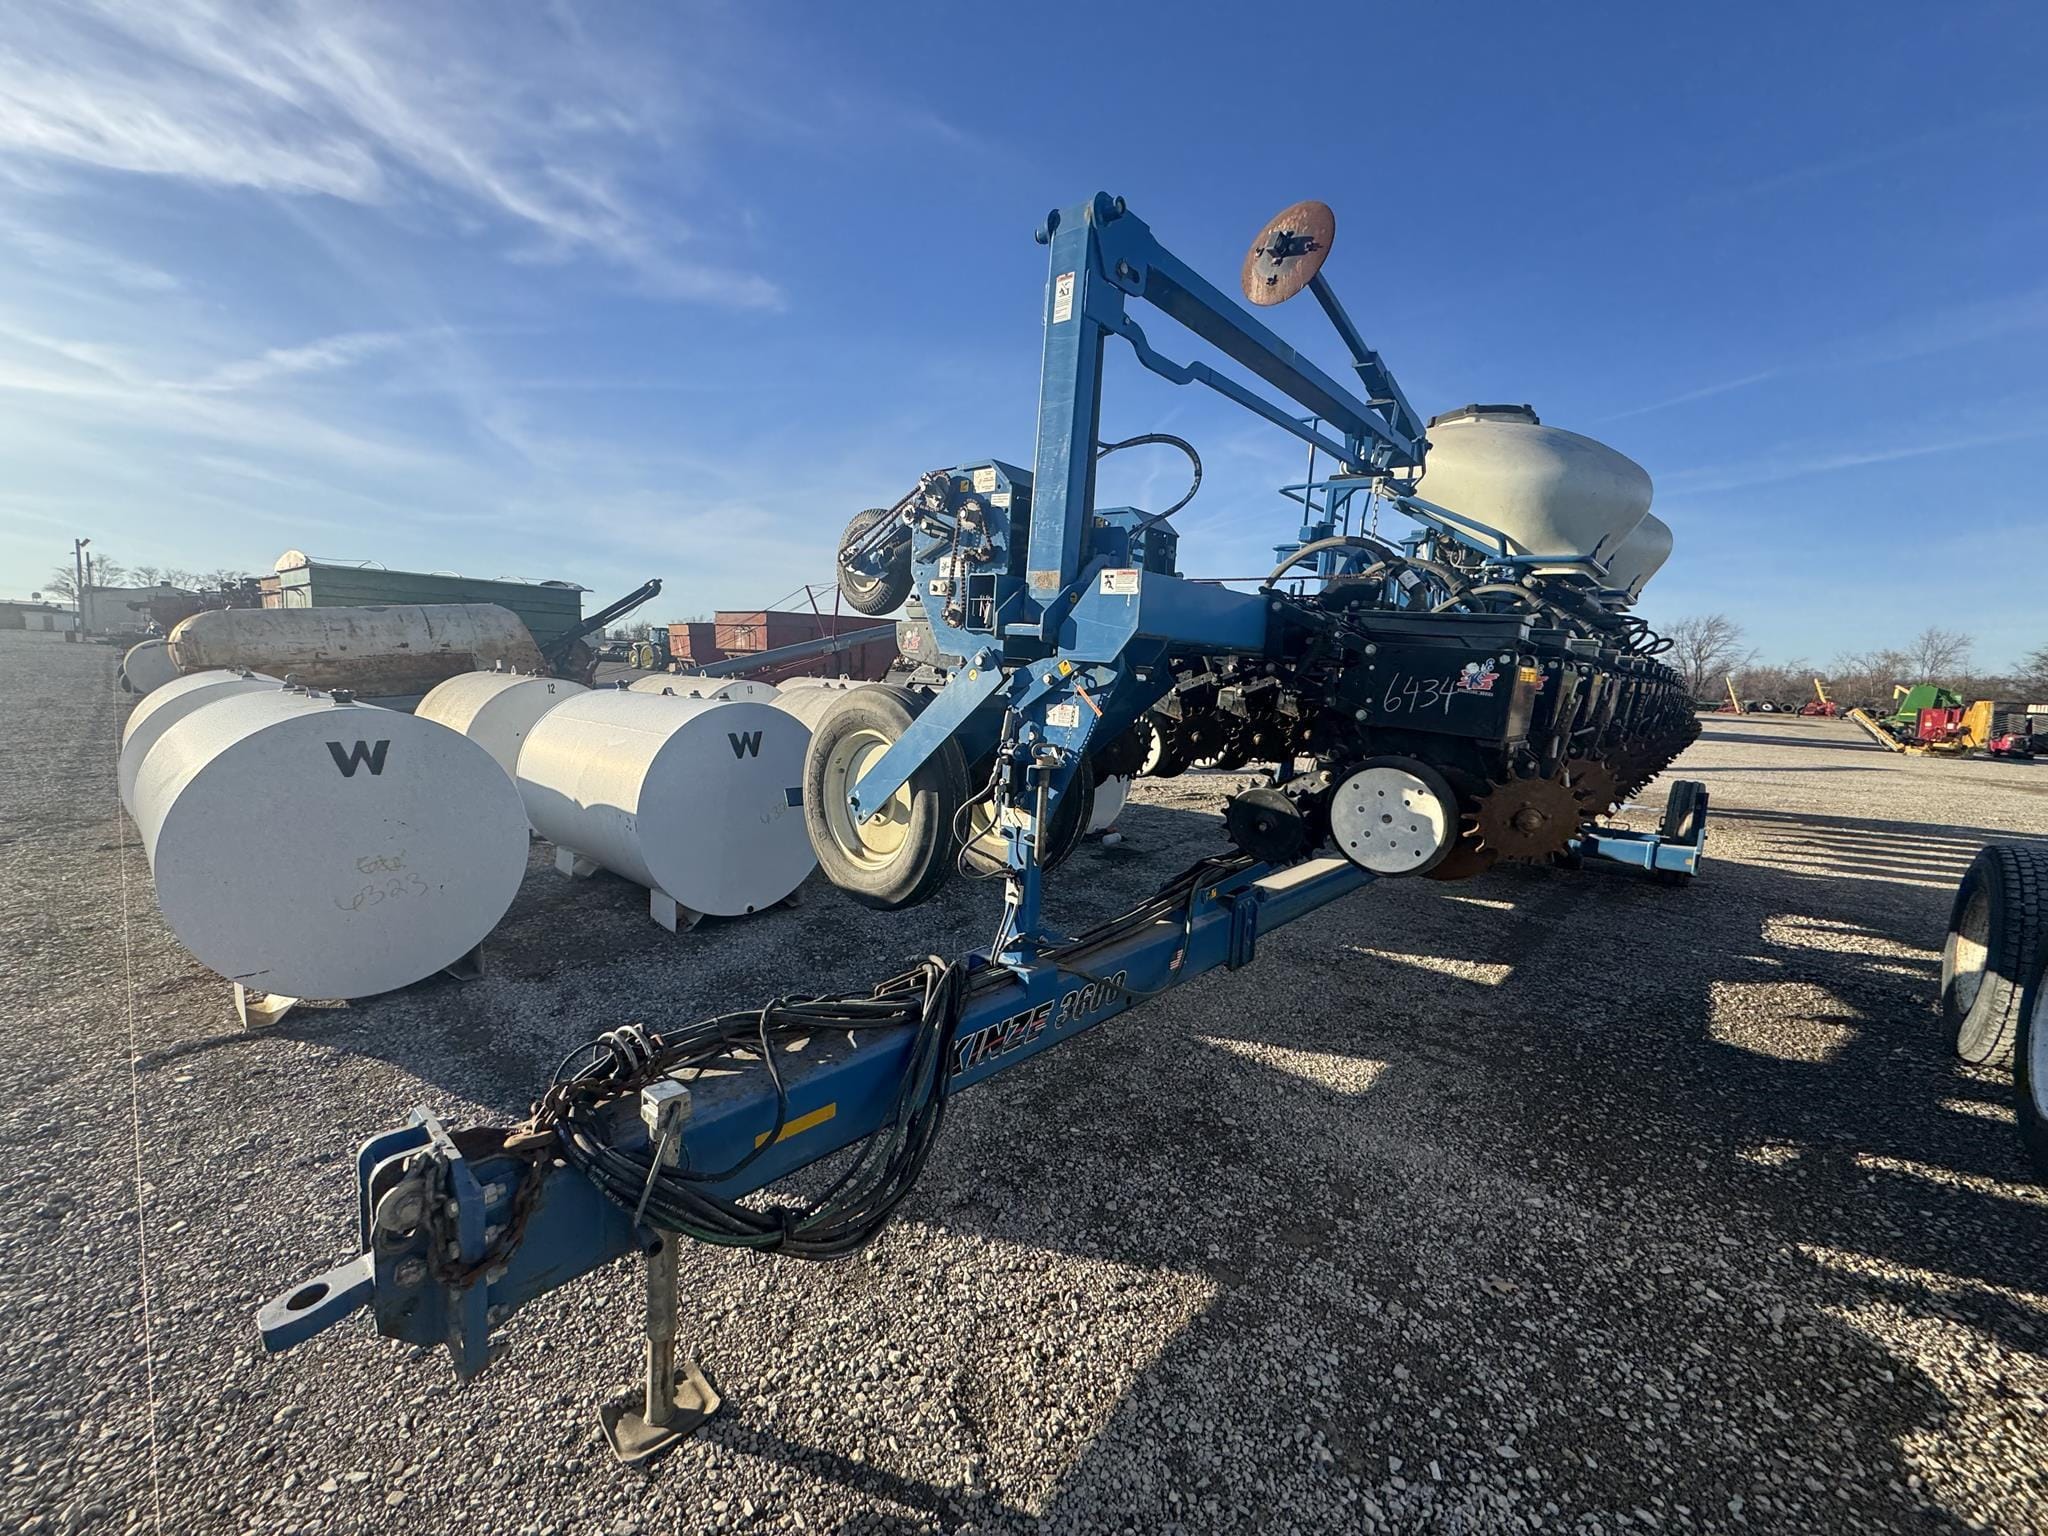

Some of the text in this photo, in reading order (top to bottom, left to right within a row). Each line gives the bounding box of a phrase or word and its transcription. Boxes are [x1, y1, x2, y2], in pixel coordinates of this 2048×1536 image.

[547, 683, 556, 694] 12
[1383, 672, 1459, 716] 6434
[325, 739, 391, 778] W
[728, 731, 763, 759] W
[333, 873, 429, 911] 6323
[1054, 969, 1128, 1030] 3600
